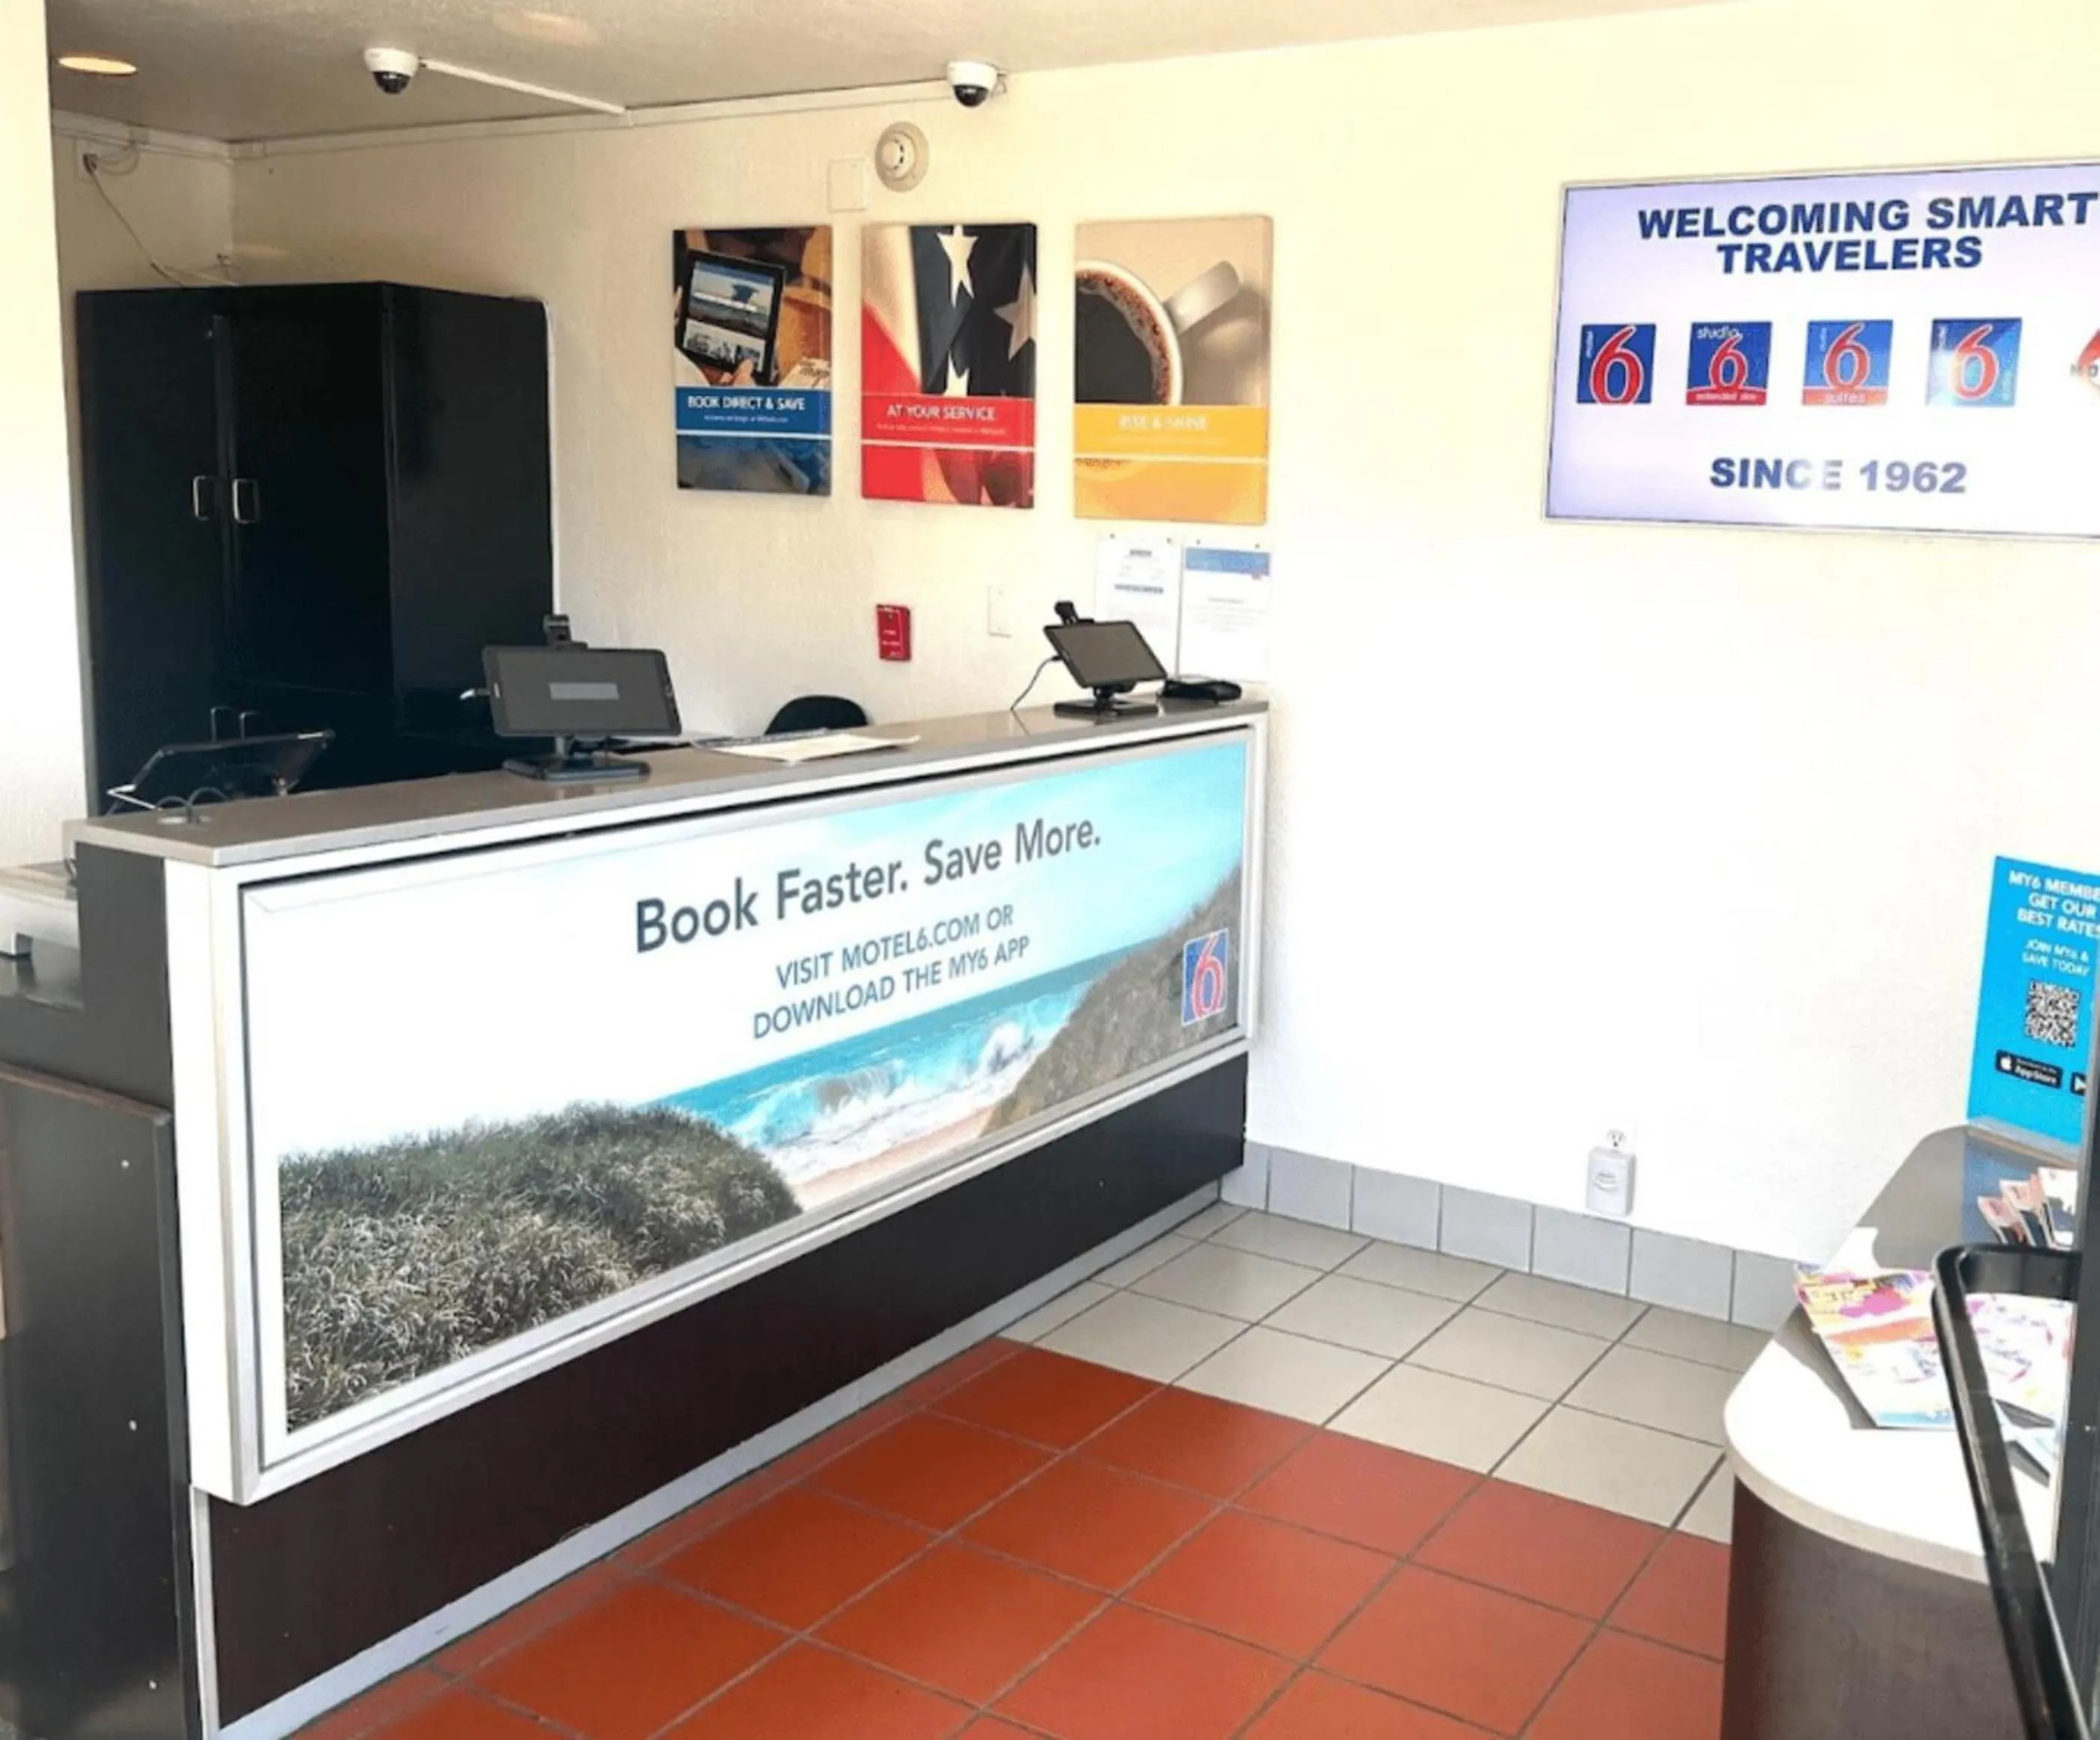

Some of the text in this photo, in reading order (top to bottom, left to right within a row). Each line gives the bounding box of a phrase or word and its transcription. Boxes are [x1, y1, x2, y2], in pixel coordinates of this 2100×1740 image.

[1638, 192, 2098, 239] WELCOMING SMART
[1716, 236, 1982, 274] TRAVELERS
[1589, 326, 1644, 405] 6
[1709, 334, 1748, 390] 6
[1823, 322, 1870, 391] 6
[1949, 324, 2000, 400] 6
[687, 396, 806, 411] BOOK DIRECT & SAVE
[886, 404, 996, 421] AT YOUR SERVICE
[1709, 457, 1966, 494] SINCE 1962
[636, 818, 1101, 954] Book Faster. Save More.
[2008, 870, 2042, 890] MY6
[2016, 907, 2054, 928] BEST
[2028, 892, 2096, 919] GET OUR
[776, 904, 1013, 990] VISIT MOTEL6.COM OR
[2021, 951, 2090, 977] SAVE TODAY
[753, 934, 1030, 1040] DOWNLOAD THE MY6 APP
